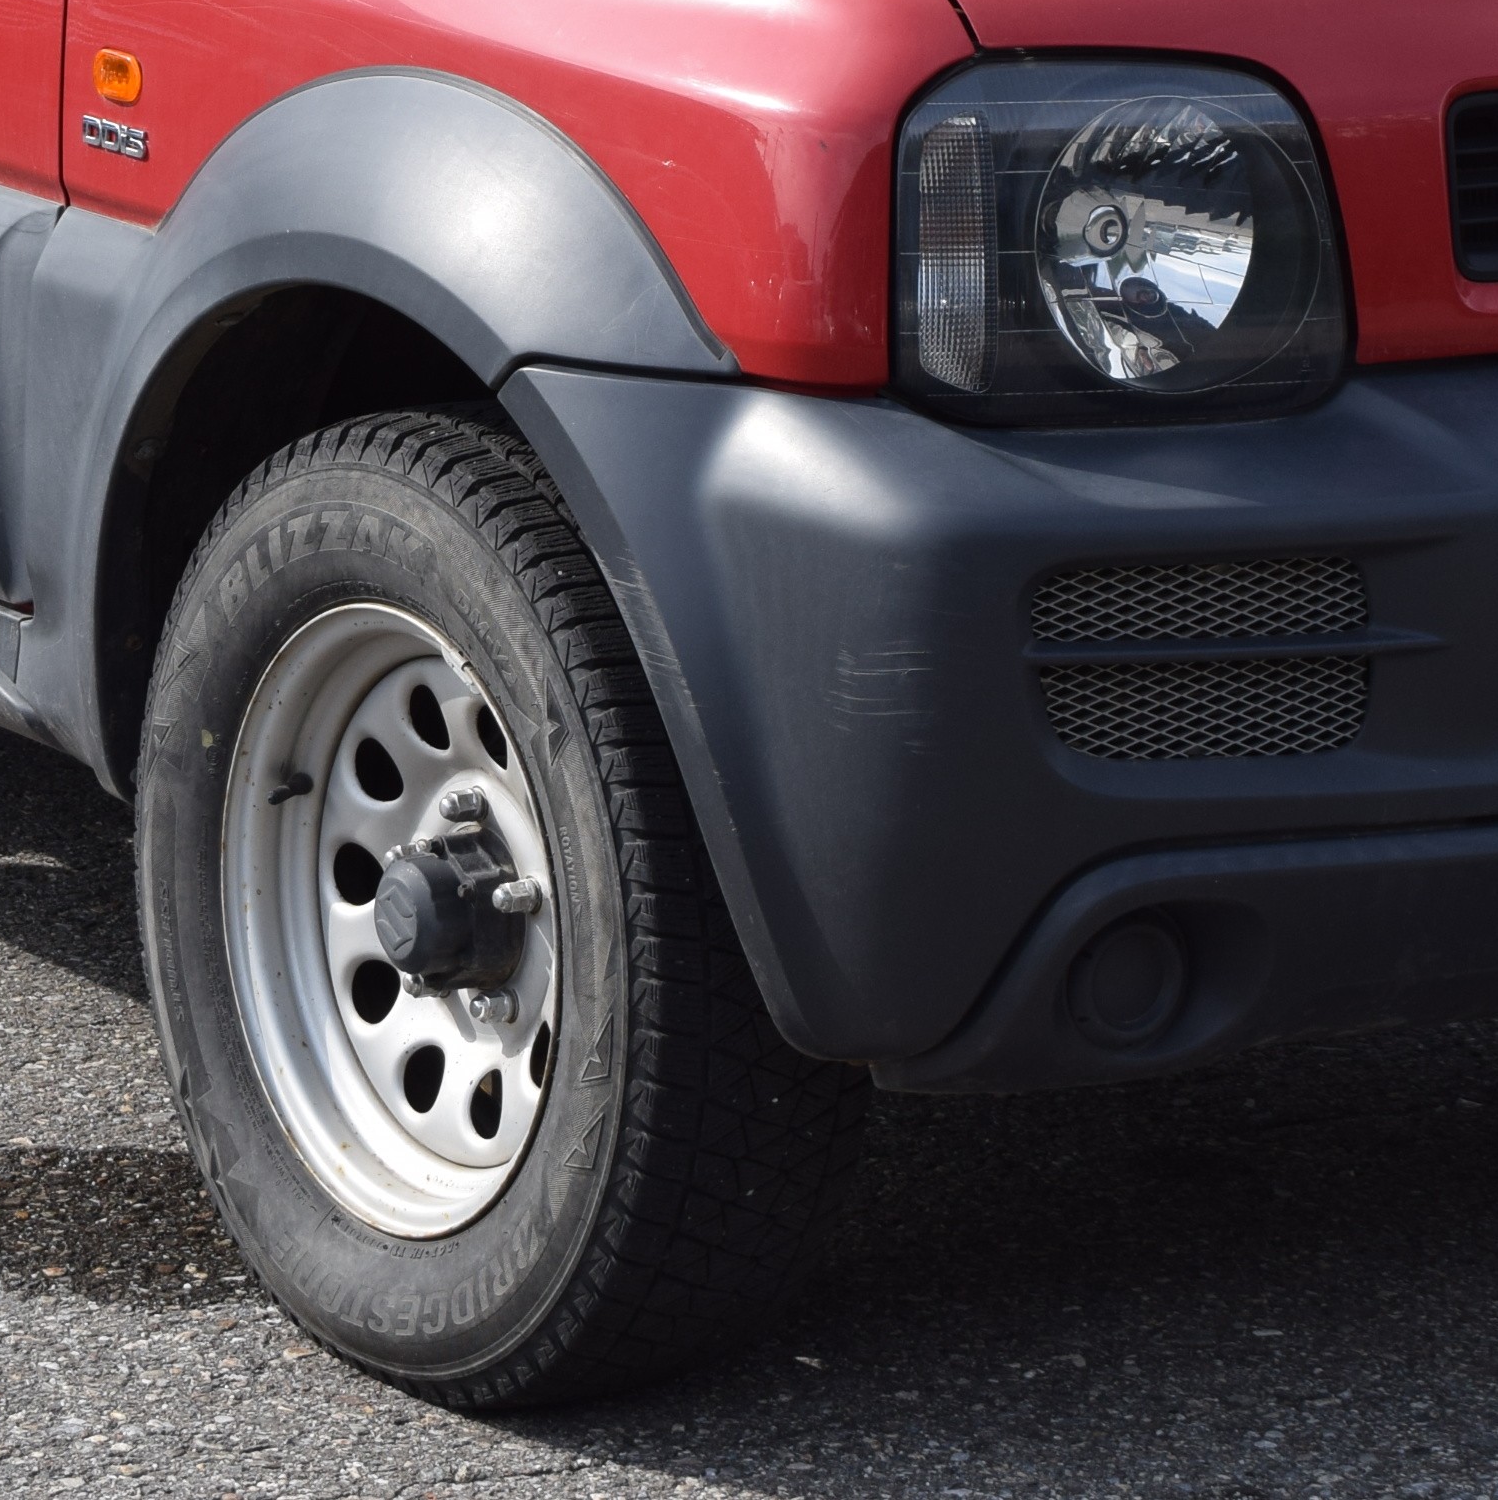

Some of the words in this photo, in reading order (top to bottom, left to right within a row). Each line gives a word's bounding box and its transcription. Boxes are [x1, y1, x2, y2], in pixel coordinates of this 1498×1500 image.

[218, 507, 434, 626] BLIZZAK
[559, 826, 581, 904] ROTATION
[268, 1208, 542, 1337] BRIDGESTONE
